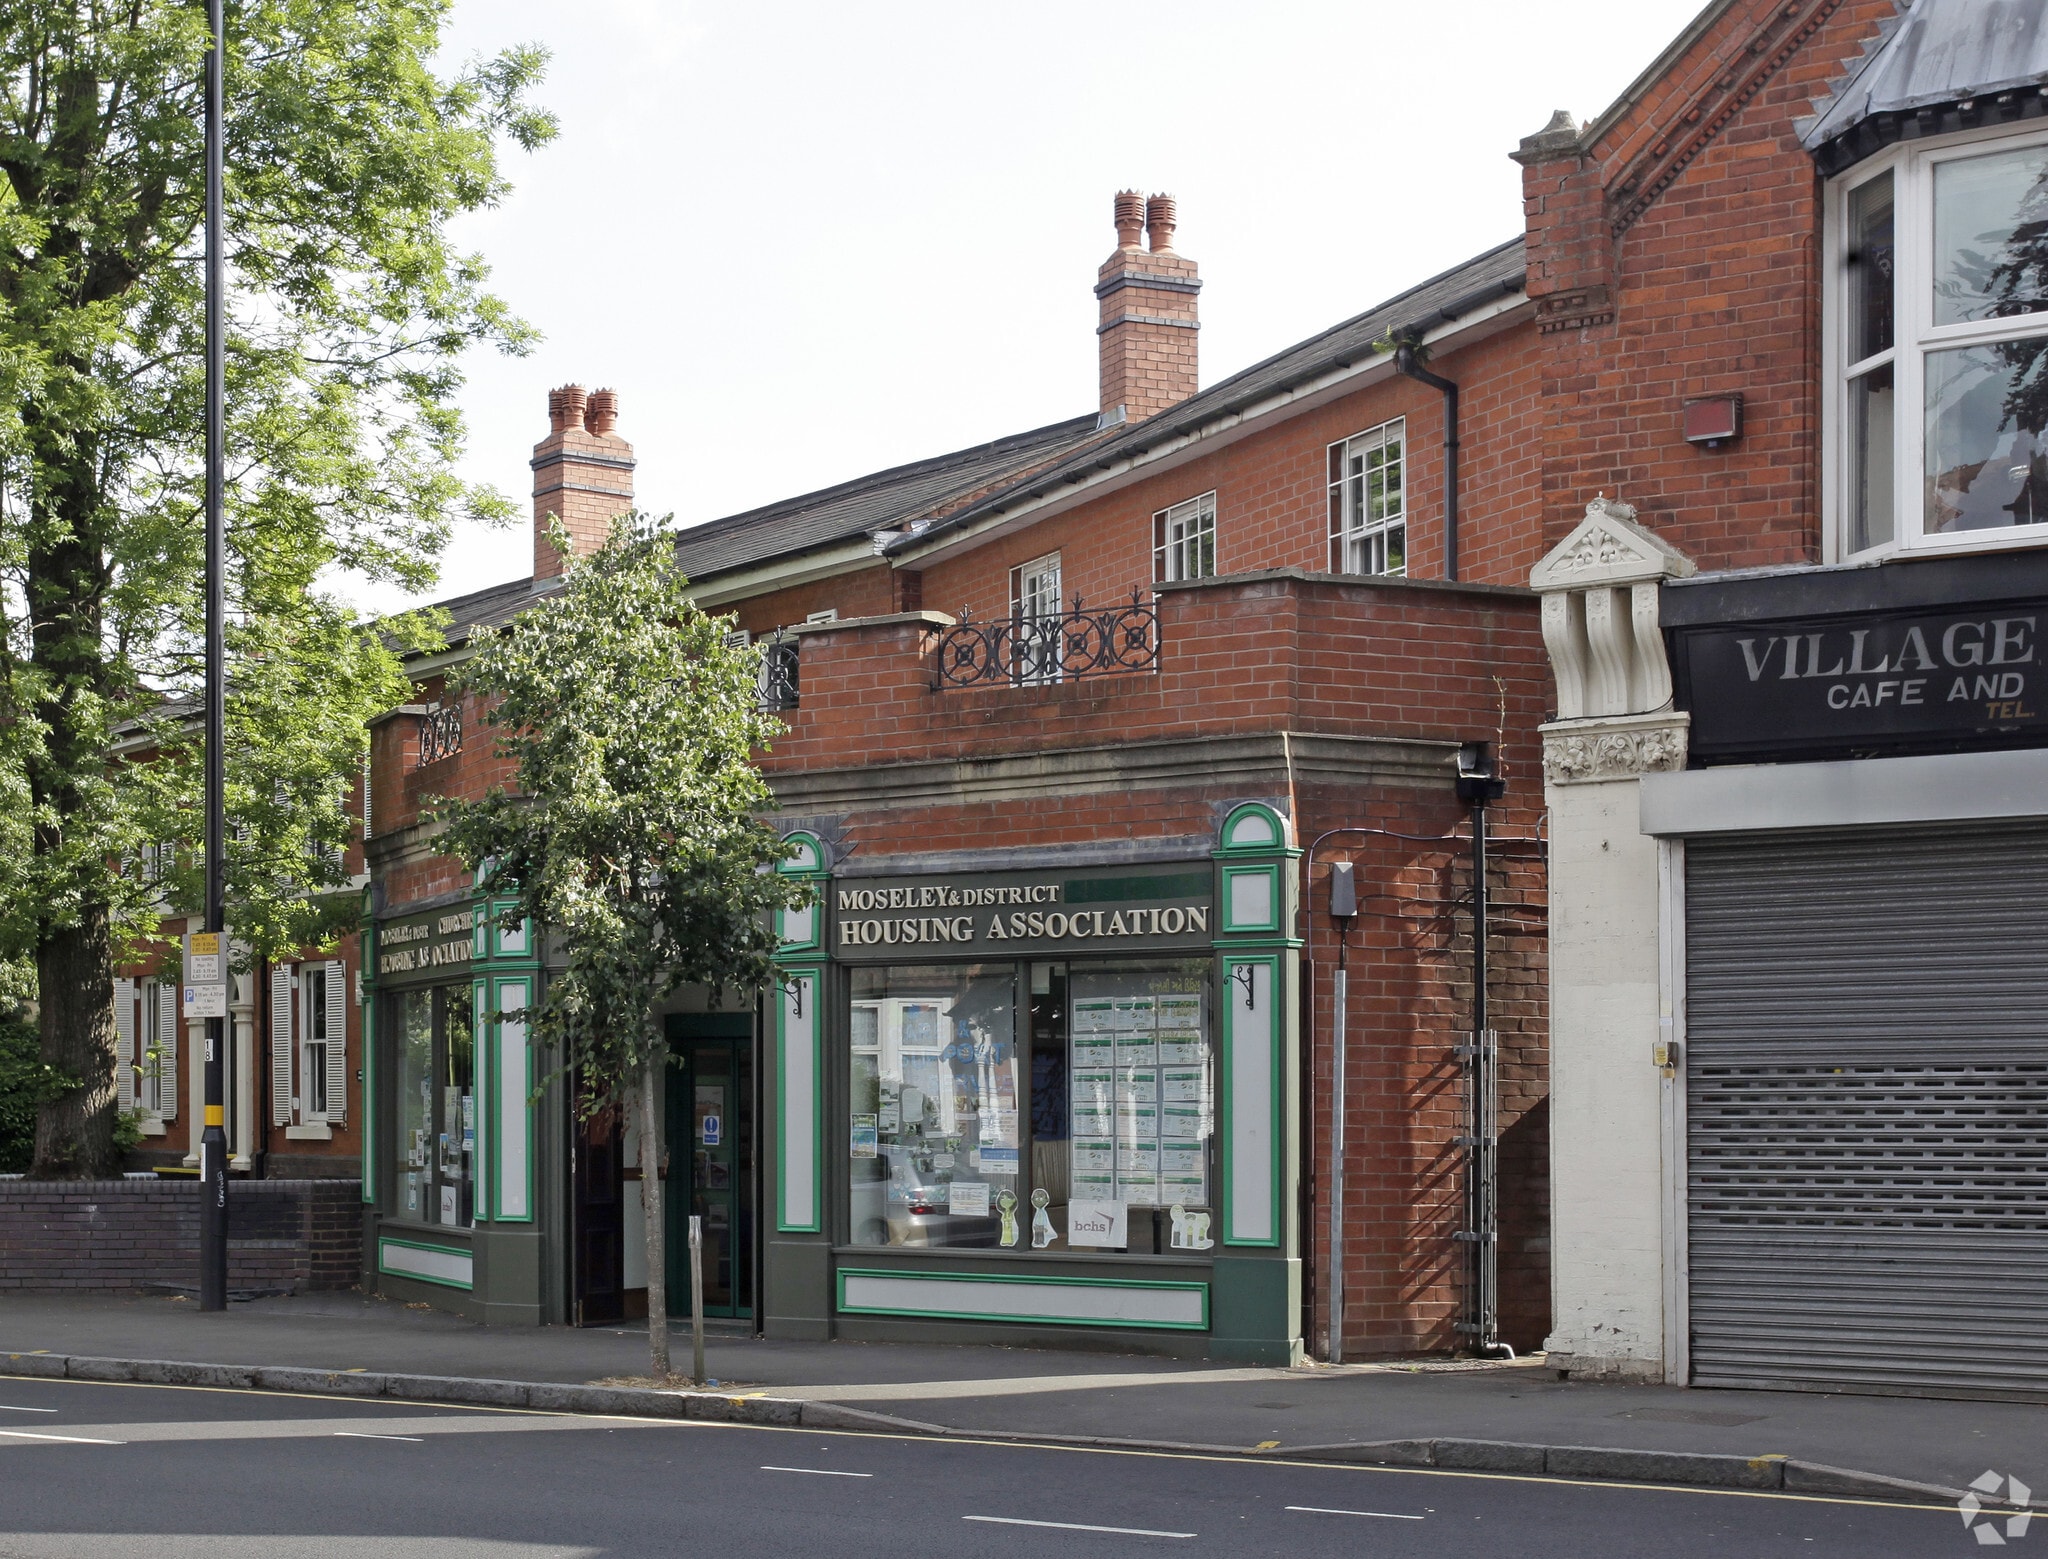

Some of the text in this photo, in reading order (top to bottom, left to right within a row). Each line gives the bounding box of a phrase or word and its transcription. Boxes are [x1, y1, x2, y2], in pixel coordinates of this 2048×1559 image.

[1736, 616, 2037, 682] VILLAGE
[1827, 672, 2024, 710] CAFE AND
[840, 905, 1210, 946] HOUSING ASSOCIATION
[186, 991, 192, 1001] P
[1074, 1221, 1106, 1232] bchs
